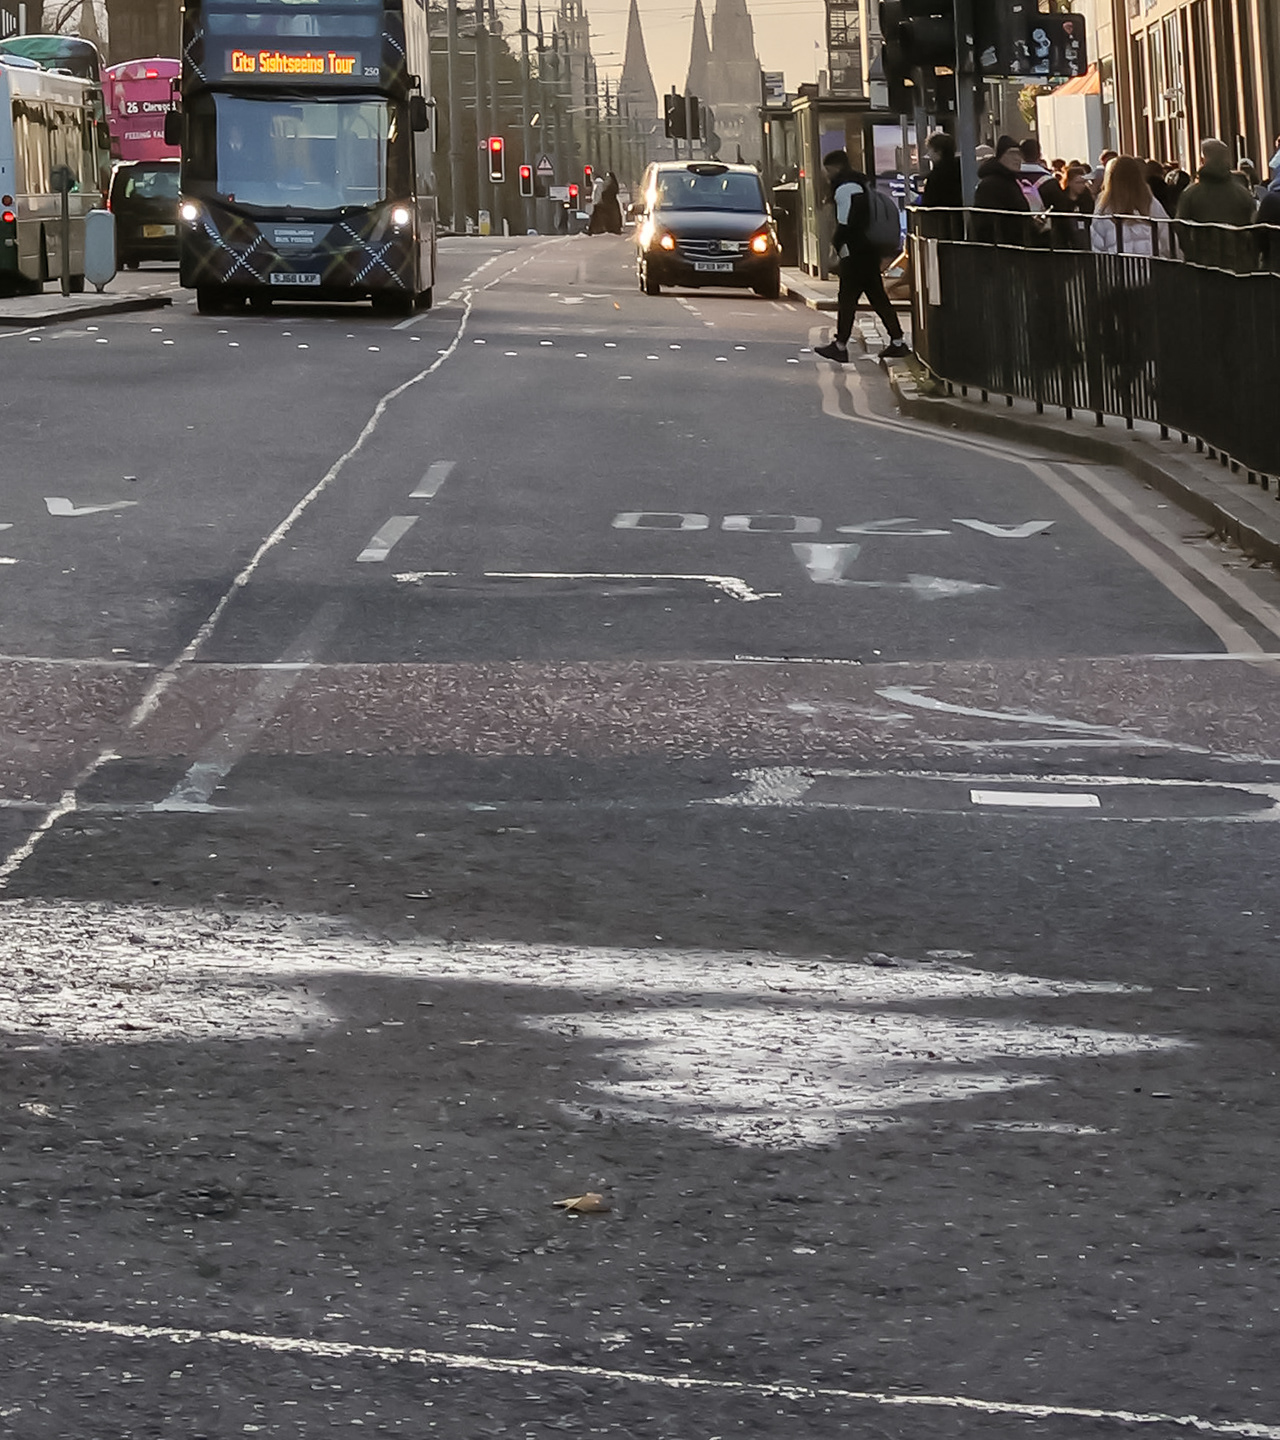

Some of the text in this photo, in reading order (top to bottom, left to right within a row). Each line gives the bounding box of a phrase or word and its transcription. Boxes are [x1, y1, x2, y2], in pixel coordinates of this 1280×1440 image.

[231, 49, 356, 74] City Sightseeing Tour
[364, 67, 379, 76] 250
[126, 101, 139, 113] 26
